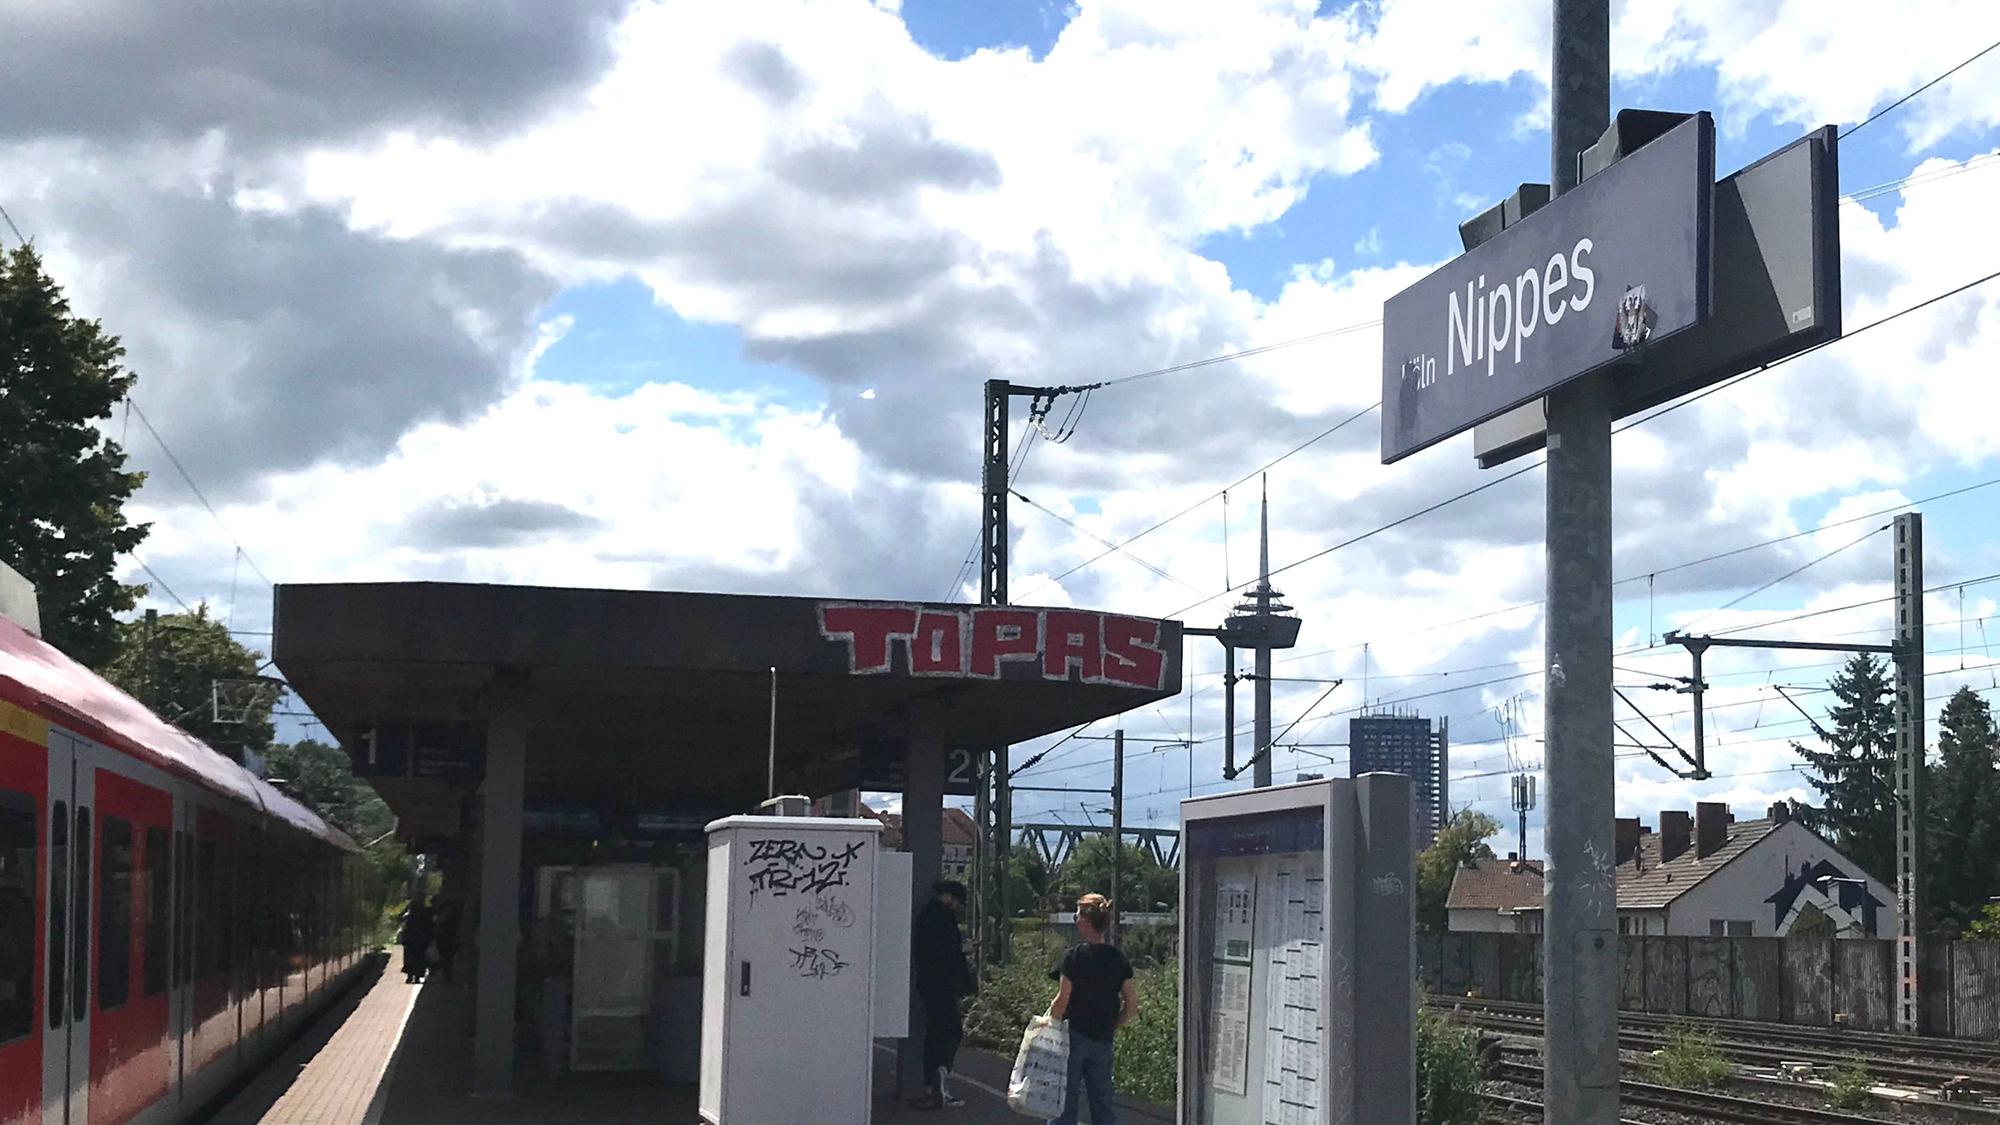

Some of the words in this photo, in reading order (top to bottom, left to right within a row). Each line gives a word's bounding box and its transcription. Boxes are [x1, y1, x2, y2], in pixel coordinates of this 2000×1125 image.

[1447, 238, 1595, 376] Nippes
[817, 601, 1168, 690] TOPAS
[360, 728, 378, 765] 1
[947, 748, 971, 783] 2
